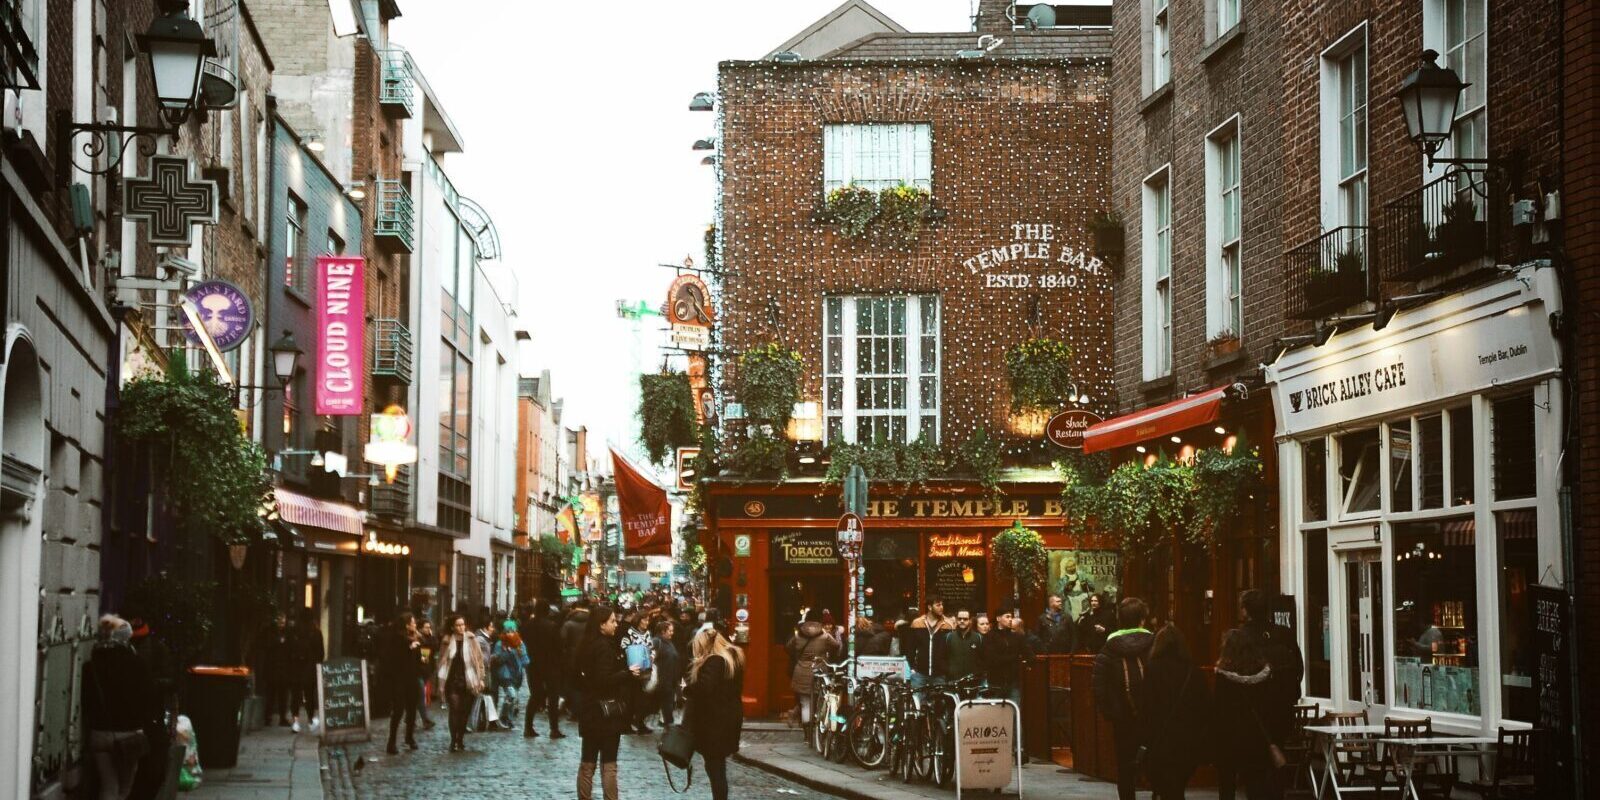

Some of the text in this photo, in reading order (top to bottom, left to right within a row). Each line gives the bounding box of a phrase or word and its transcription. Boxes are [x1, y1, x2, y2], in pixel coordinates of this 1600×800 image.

[1010, 223, 1054, 240] THE
[963, 242, 1104, 275] TEMPLE BAR
[327, 262, 355, 315] NINE
[1039, 275, 1077, 288] 1840
[325, 321, 354, 392] CLOUD
[1478, 352, 1497, 365] Temple
[1509, 344, 1528, 357] Dublin
[1305, 355, 1406, 410] BRICK ALLEY CAFÉ
[911, 500, 1028, 516] TEMPLE
[929, 532, 982, 546] Traditional
[781, 543, 833, 560] TOBACCO
[928, 546, 983, 557] Irish Music
[963, 726, 1008, 739] ARIOSA
